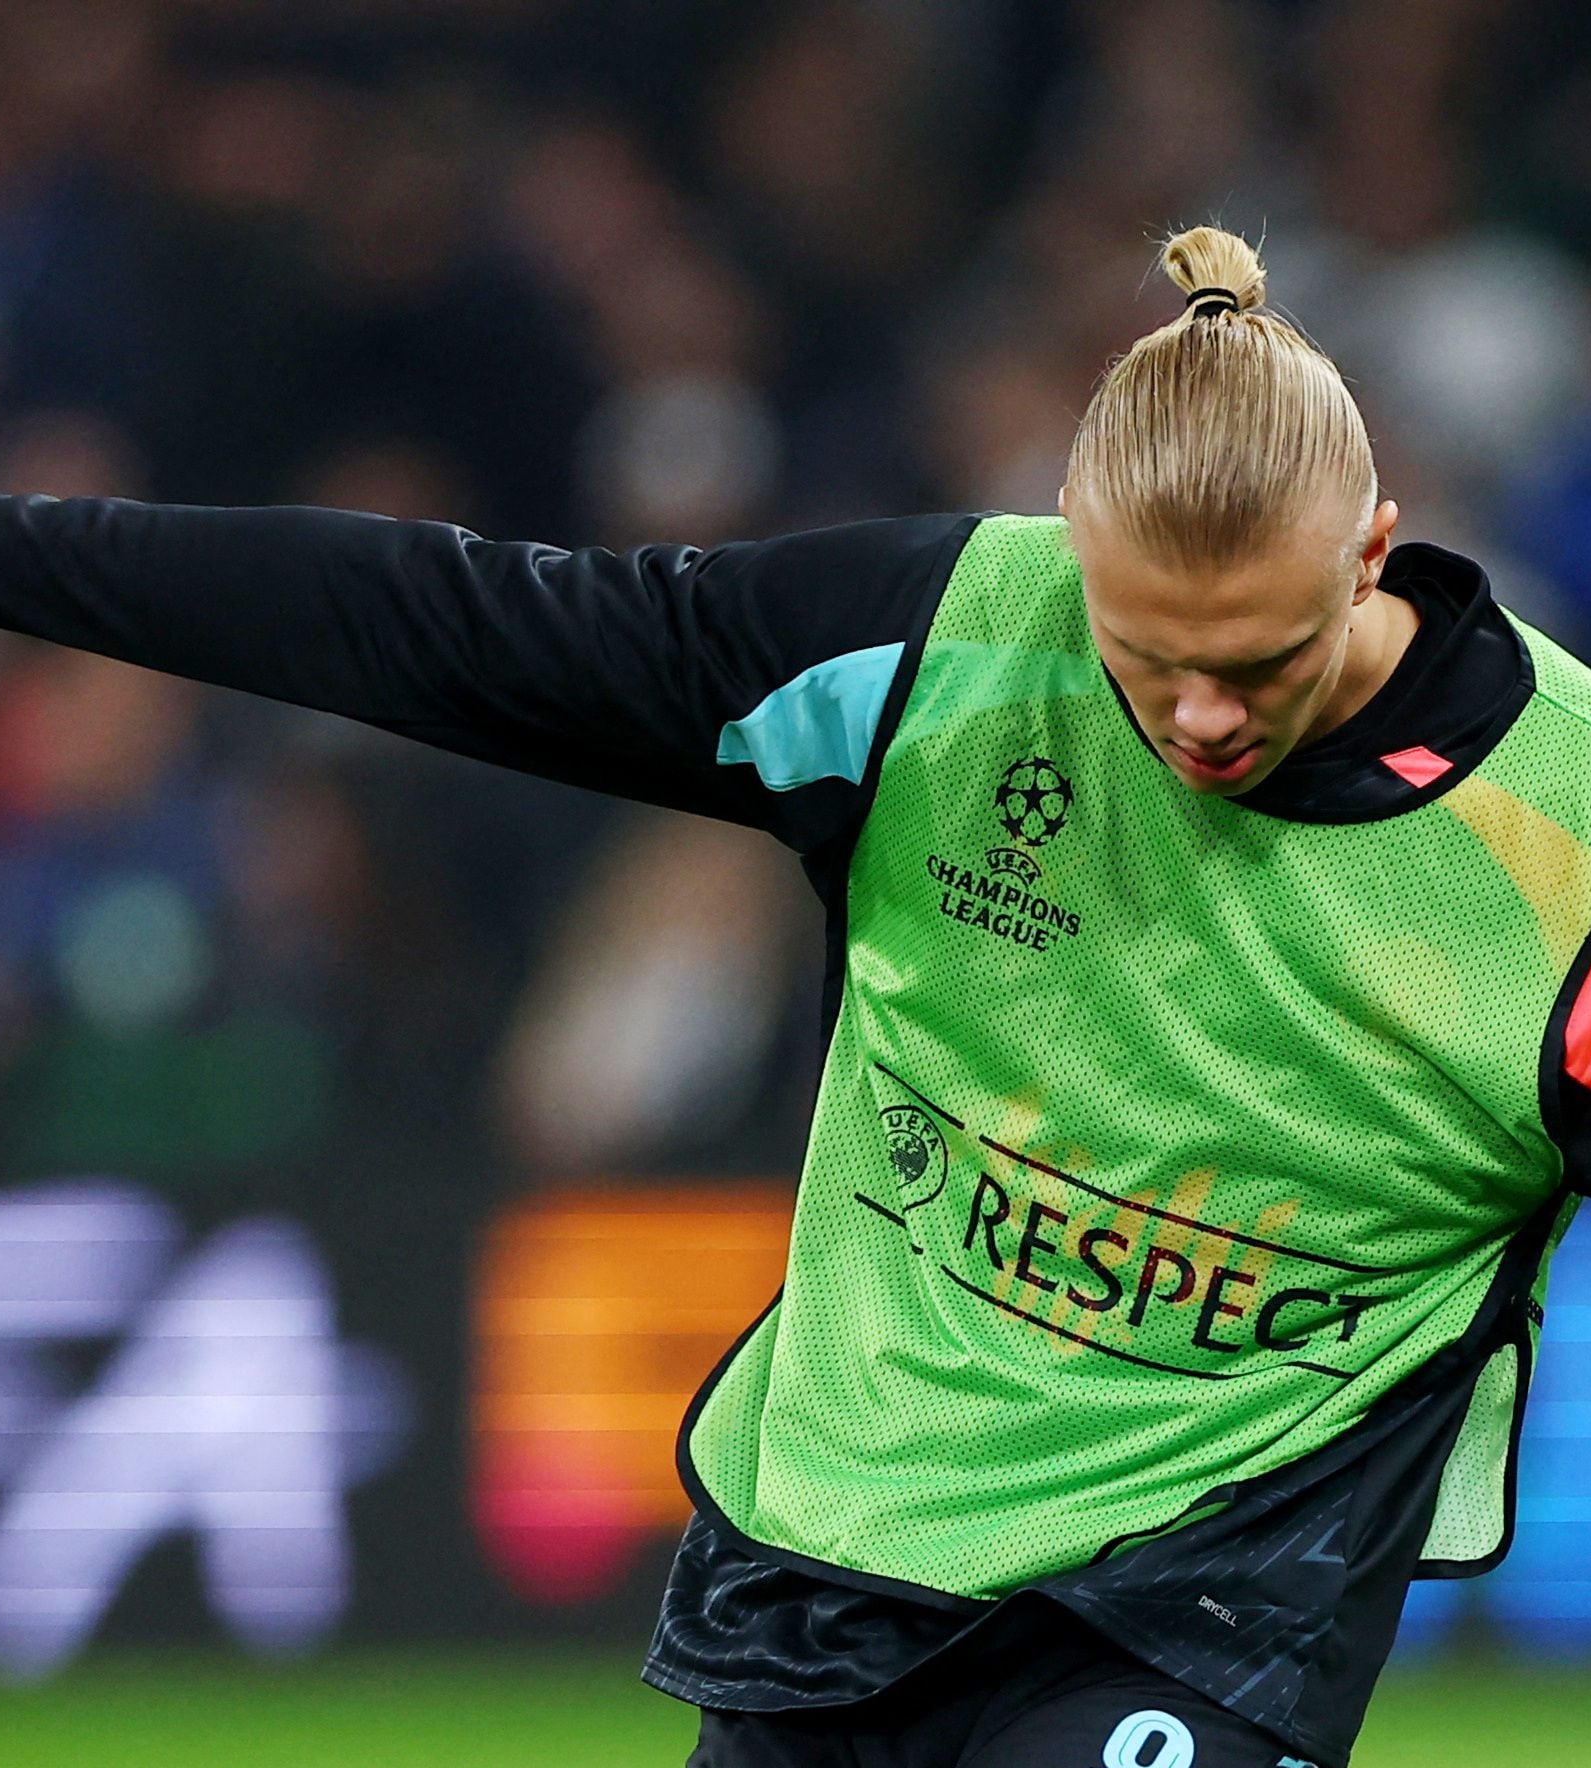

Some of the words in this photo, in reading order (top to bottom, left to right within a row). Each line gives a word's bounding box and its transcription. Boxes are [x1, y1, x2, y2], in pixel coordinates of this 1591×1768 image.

[986, 852, 1040, 886] UEFA
[926, 854, 1081, 937] CHAMPIONS
[940, 891, 1050, 952] LEAGUE
[887, 1112, 939, 1152] UEFA
[963, 1172, 1380, 1353] RESPECT
[1198, 1595, 1237, 1627] DRYCELL
